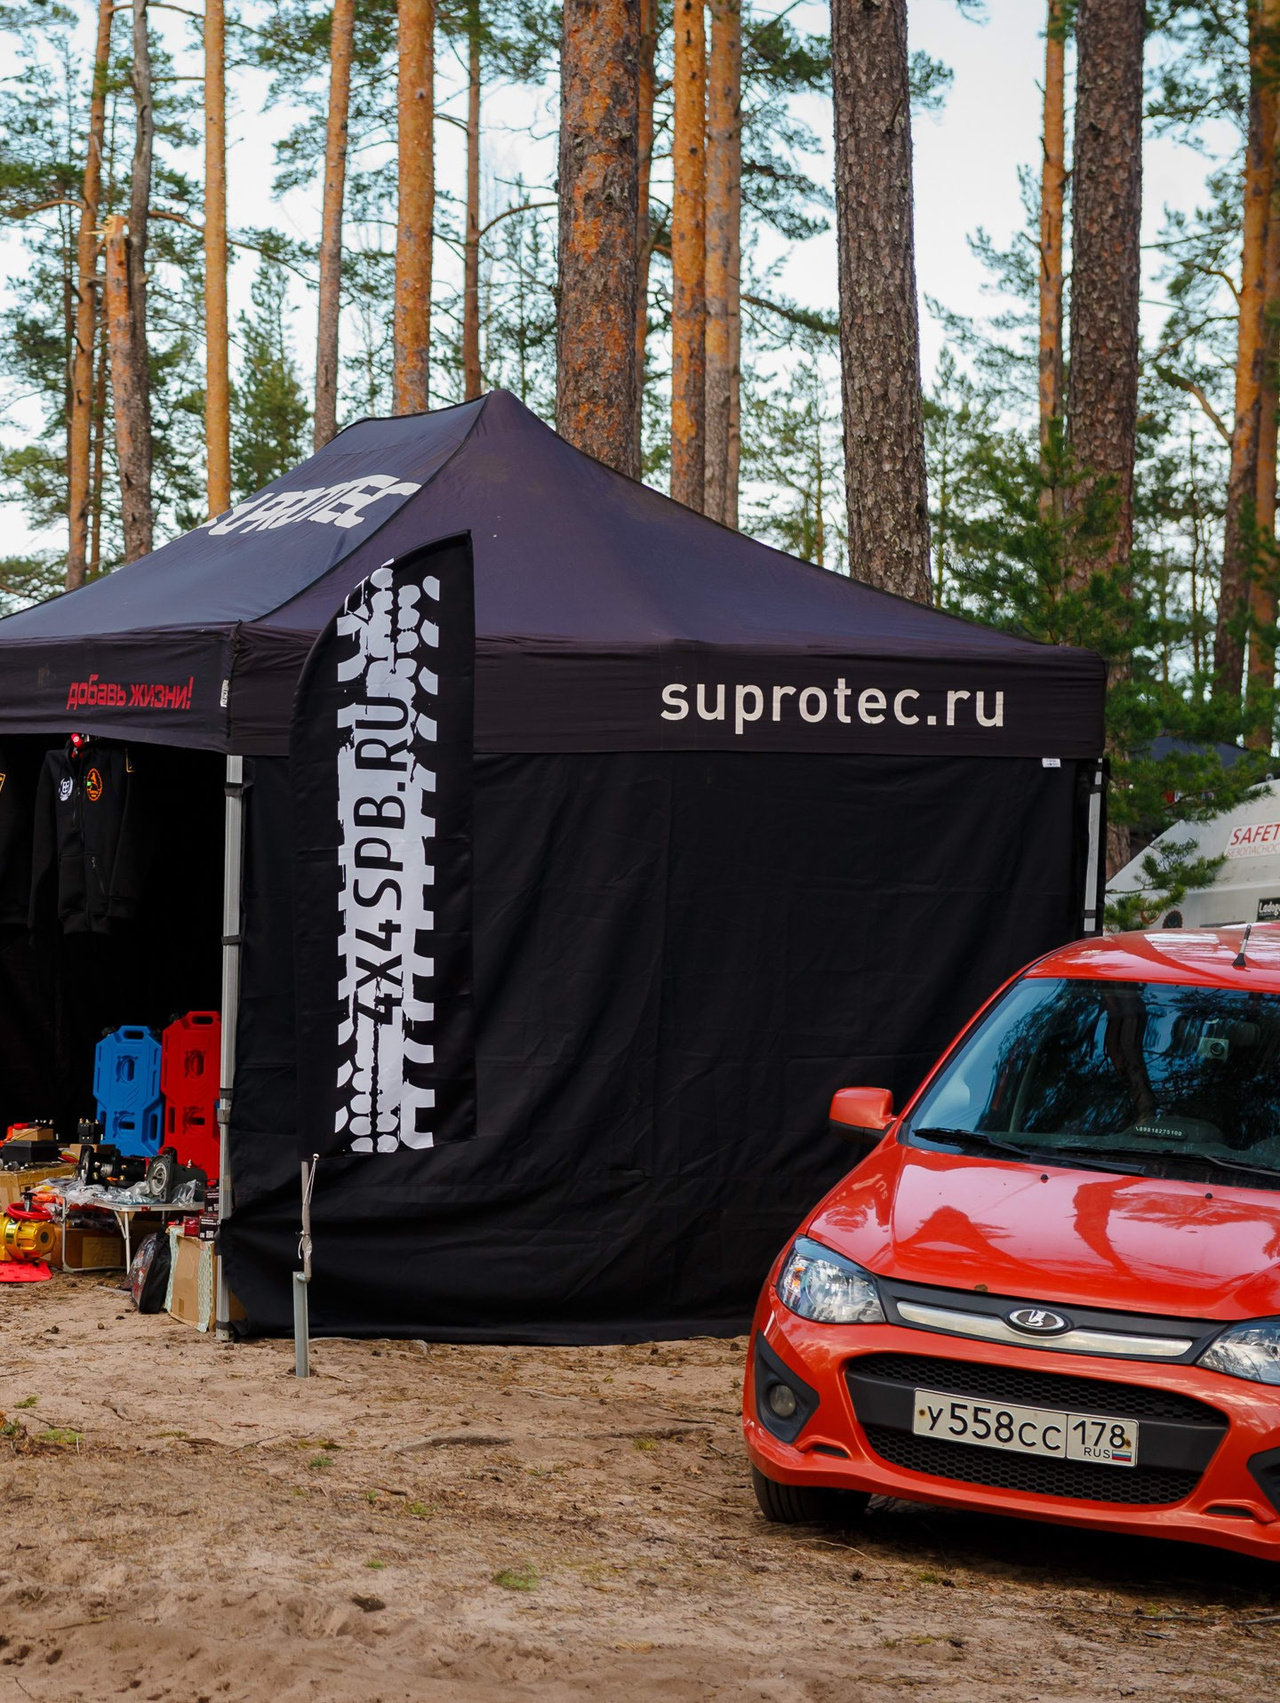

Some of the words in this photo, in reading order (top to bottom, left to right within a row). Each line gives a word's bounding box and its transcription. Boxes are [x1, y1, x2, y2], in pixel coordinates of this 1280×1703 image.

[197, 474, 422, 535] UPROTEC
[66, 674, 126, 710] добавь
[128, 676, 194, 709] жизни!
[660, 678, 1004, 735] suprotec.ru
[353, 696, 409, 1025] 4X4SPB.RU
[1072, 1418, 1126, 1448] 178
[1083, 1446, 1111, 1459] RUS
